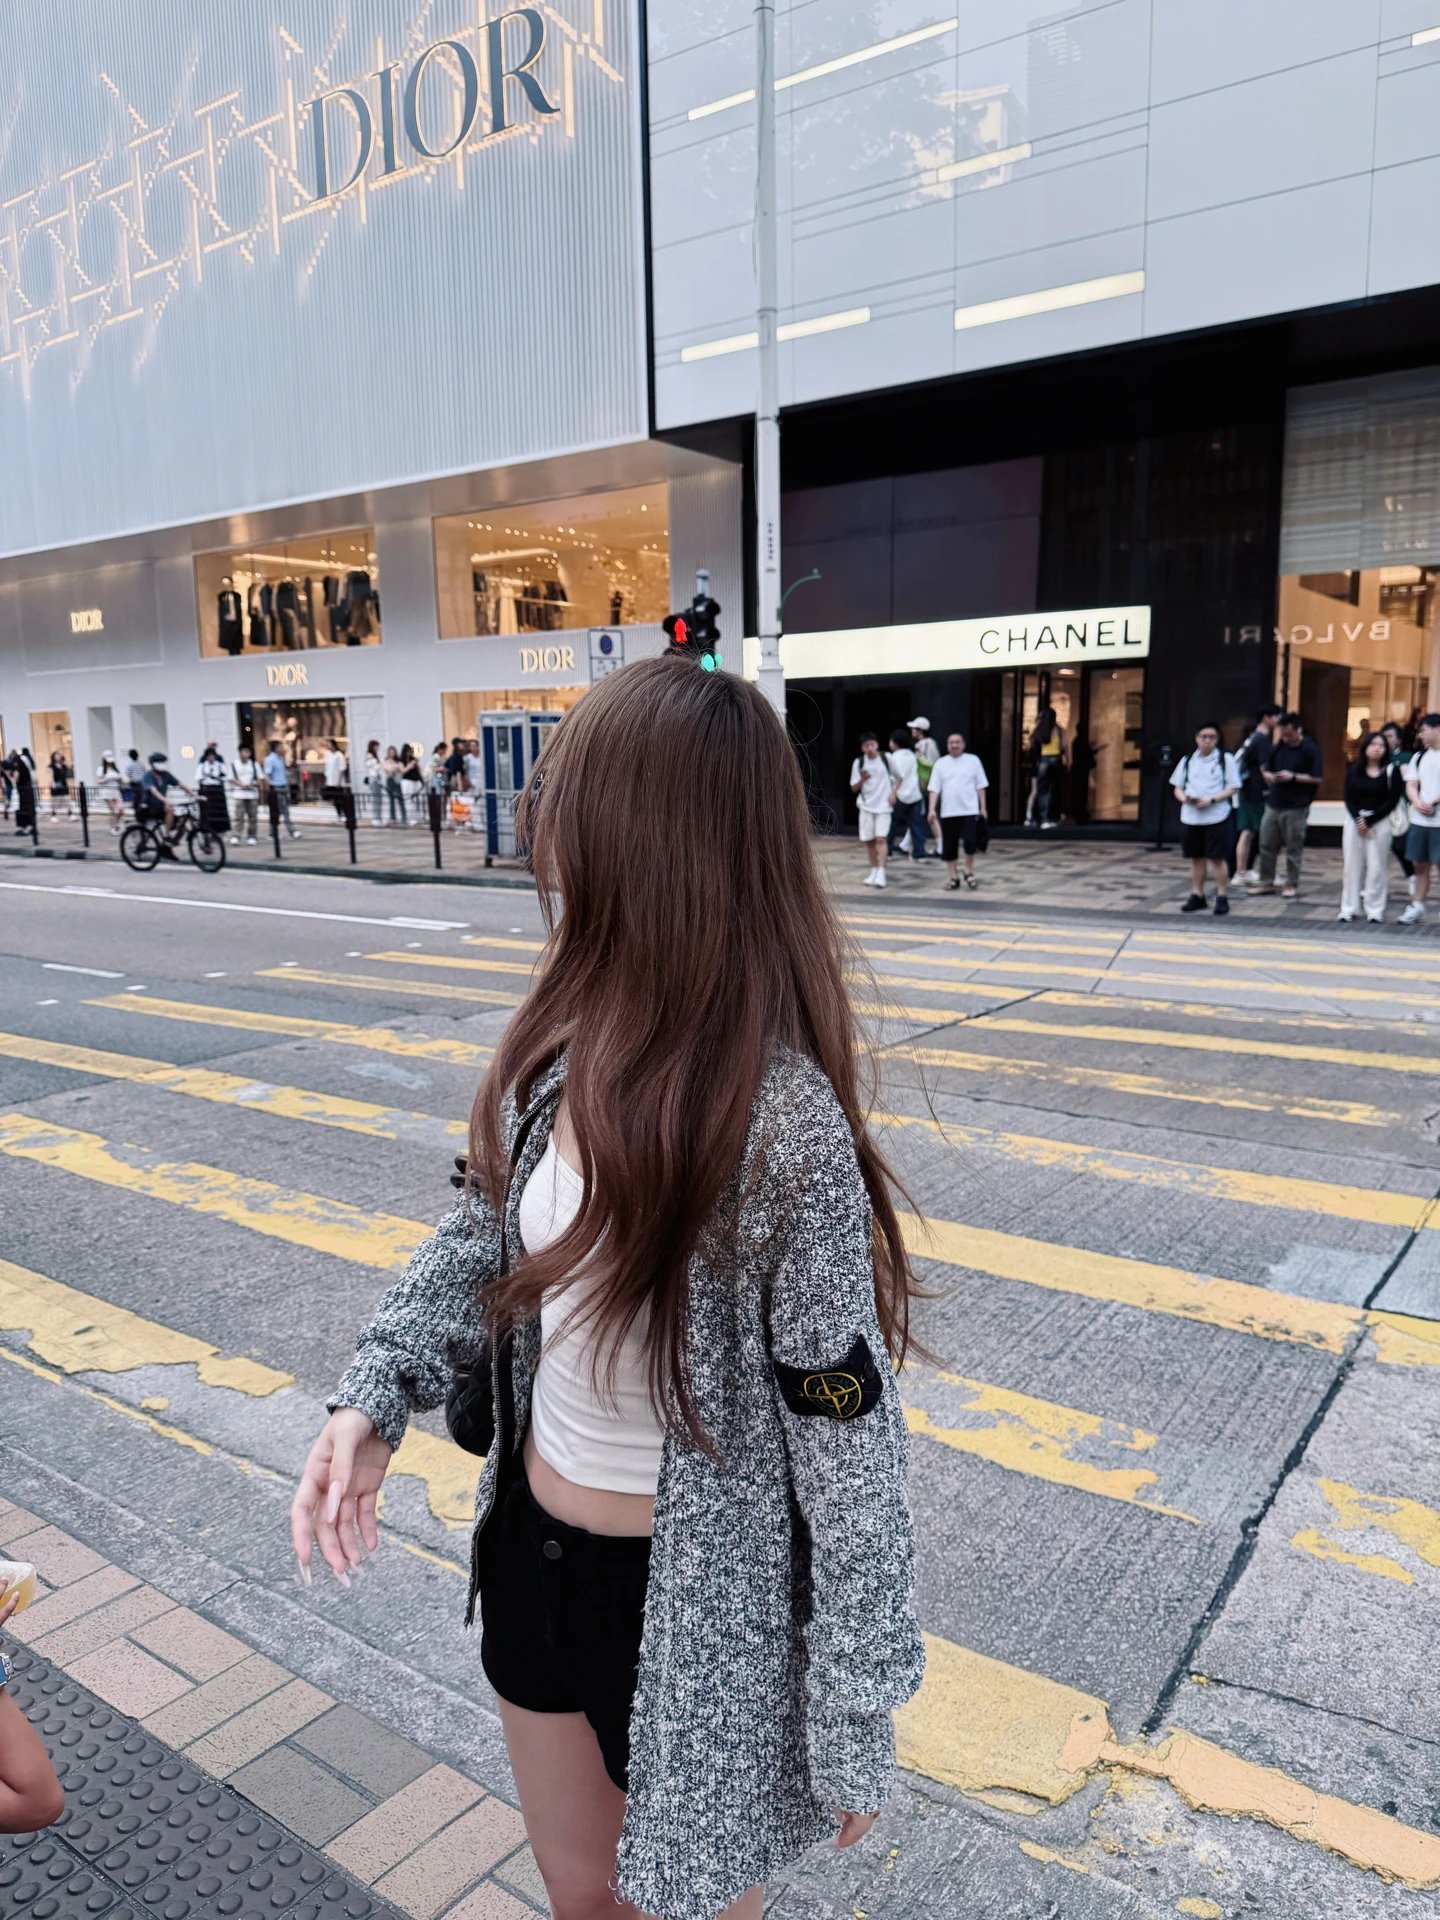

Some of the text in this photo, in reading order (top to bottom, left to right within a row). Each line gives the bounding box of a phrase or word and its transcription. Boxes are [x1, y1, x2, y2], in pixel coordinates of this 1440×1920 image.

[303, 8, 561, 205] DIOR
[71, 609, 104, 632] DIOR
[979, 619, 1142, 654] CHANEL
[520, 646, 575, 673] DIOR
[266, 663, 309, 687] DIOR
